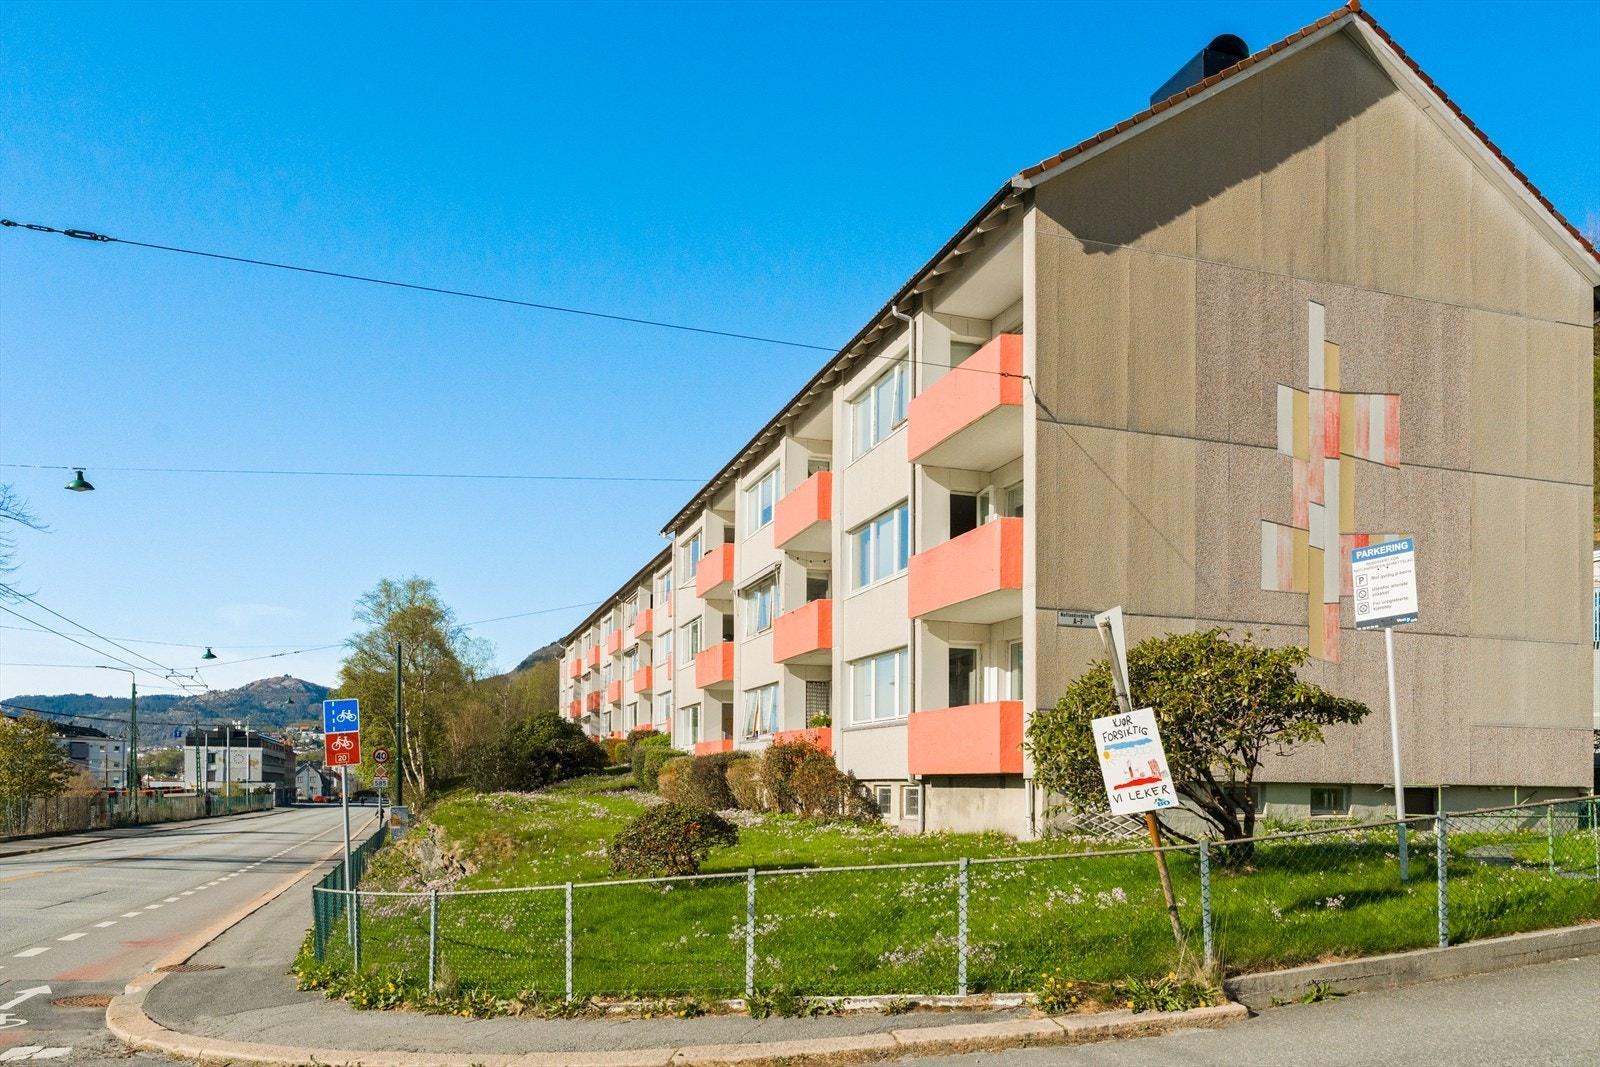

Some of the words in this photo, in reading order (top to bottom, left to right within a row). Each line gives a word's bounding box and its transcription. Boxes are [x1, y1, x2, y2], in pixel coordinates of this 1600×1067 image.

[1356, 542, 1408, 560] PARKERING
[1112, 715, 1133, 728] KJØR
[1102, 726, 1148, 742] FORSIKTIG
[1112, 794, 1122, 804] VI
[1129, 784, 1170, 800] LEKER
